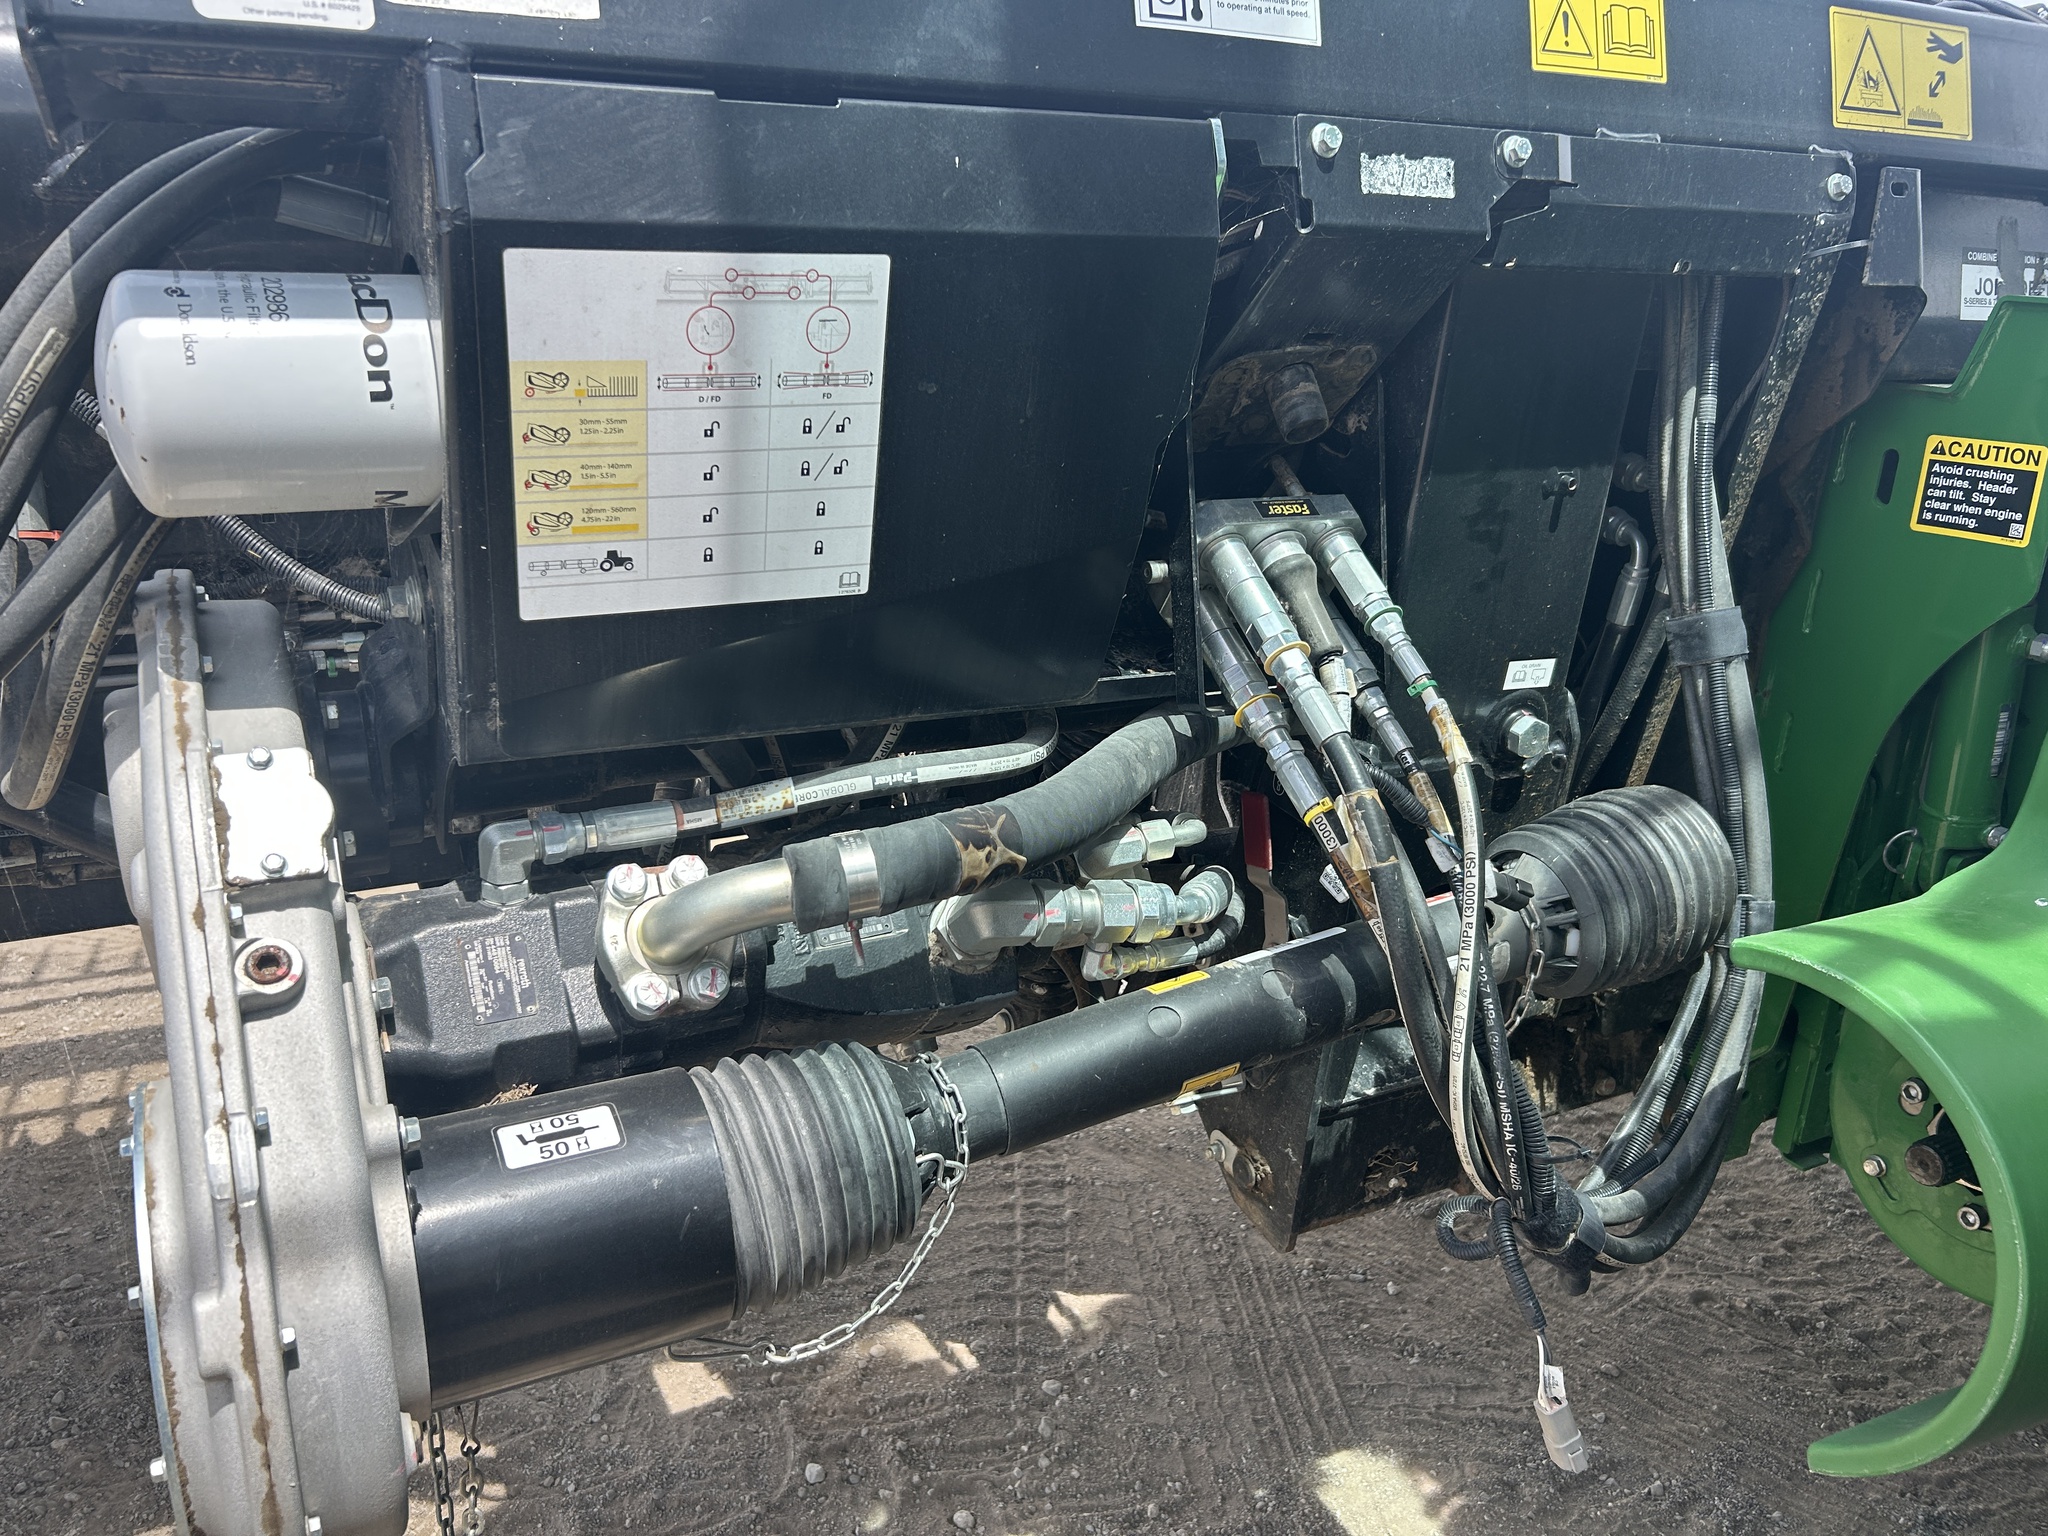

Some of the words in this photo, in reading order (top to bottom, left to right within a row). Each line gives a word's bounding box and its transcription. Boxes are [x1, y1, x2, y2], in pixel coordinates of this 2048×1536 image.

[1227, 2, 1263, 15] operating
[1264, 6, 1272, 14] at
[1273, 7, 1285, 15] full
[1286, 9, 1310, 18] speed.
[1967, 251, 1998, 262] COMBINE
[261, 277, 290, 322] 202986
[177, 303, 199, 366] Donldson
[345, 273, 394, 403] acDon
[822, 392, 832, 400] FD
[1948, 441, 2042, 466] CAUTION
[1931, 462, 1964, 476] Avoid
[1965, 468, 2015, 484] crushing
[1929, 474, 1972, 489] injuries.
[1977, 481, 2018, 495] Header
[1927, 488, 1946, 498] can
[1948, 489, 1966, 501] tilt.
[1971, 492, 1997, 507] Stay
[1268, 503, 1311, 516] Faster
[1922, 509, 1932, 520] is
[1934, 514, 1979, 529] running.
[1924, 499, 1951, 511] clear
[1953, 503, 1982, 515] when
[1984, 508, 2023, 521] engine
[73, 660, 97, 688] MPa
[892, 723, 902, 736] 21
[1313, 815, 1339, 850] (3000
[1465, 851, 1477, 880] PSI)
[1463, 881, 1476, 919] (3000
[1461, 921, 1474, 951] MPa
[517, 957, 531, 988] rexroth
[1460, 956, 1470, 972] 21
[549, 1113, 580, 1129] 50
[1499, 1102, 1514, 1142] MSHA
[539, 1141, 570, 1160] 50
